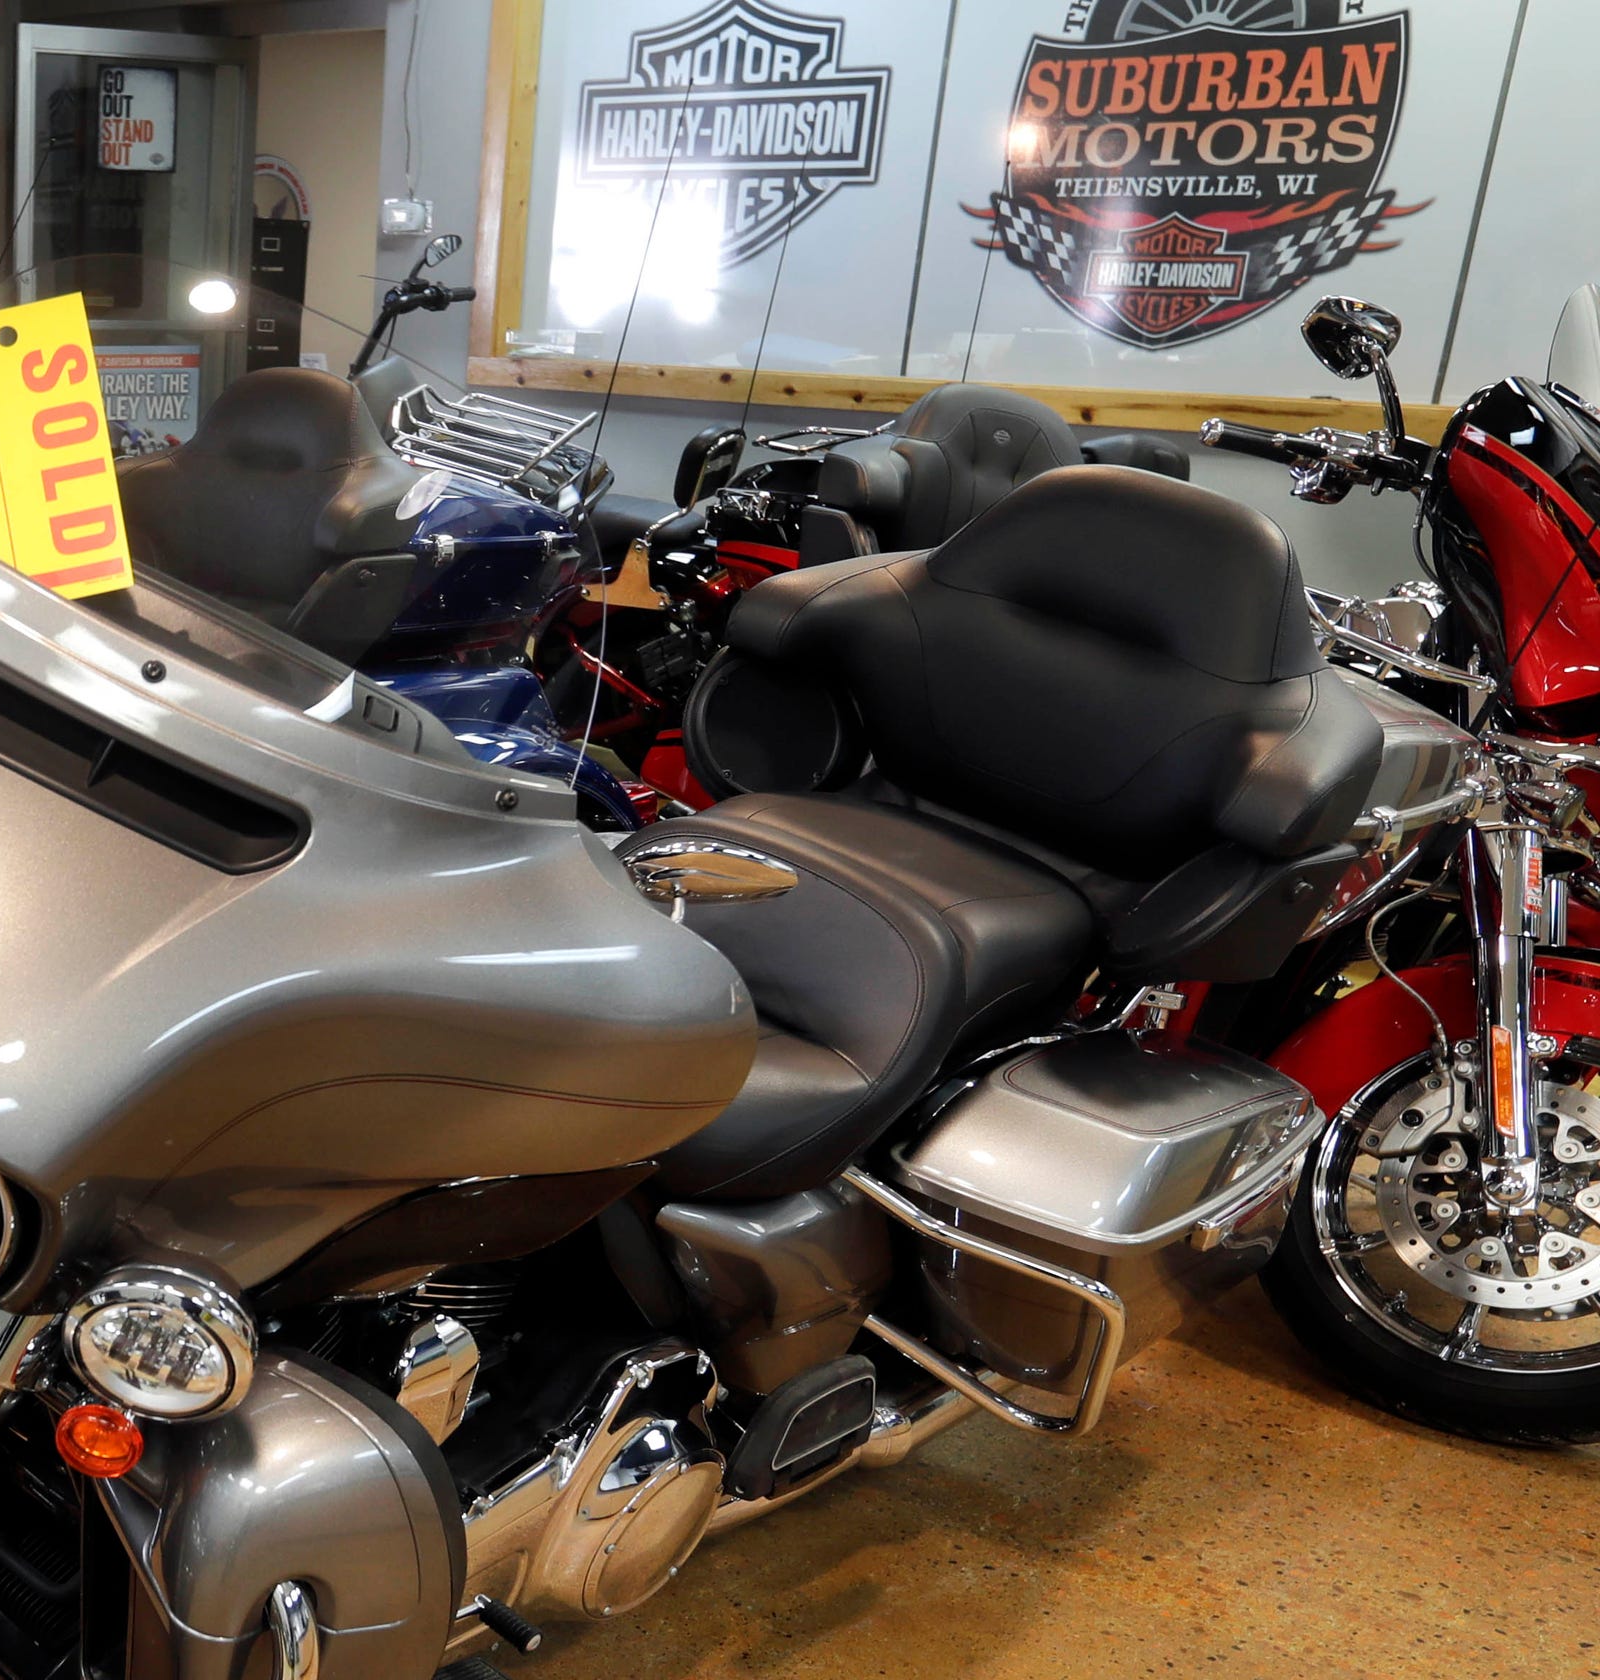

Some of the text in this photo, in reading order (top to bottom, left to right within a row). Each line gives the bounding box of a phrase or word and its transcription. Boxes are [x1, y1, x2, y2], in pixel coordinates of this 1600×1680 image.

[663, 24, 801, 87] MOTOR
[103, 70, 124, 93] GO
[1025, 42, 1396, 118] SUBURBAN
[103, 95, 134, 118] OUT
[102, 119, 154, 143] STAND
[601, 99, 859, 159] HARLEY-DAVIDSON
[1017, 114, 1379, 169] MOTORS
[102, 143, 133, 166] OUT
[1055, 174, 1319, 200] THIENSVILLE, WI
[1134, 228, 1207, 255] MOTOR
[1098, 262, 1236, 288] HARLEY-DAVIDSON
[1125, 295, 1196, 325] CYCLES
[161, 373, 189, 394] THE
[145, 396, 188, 420] WAY.
[21, 343, 118, 556] SOLD
